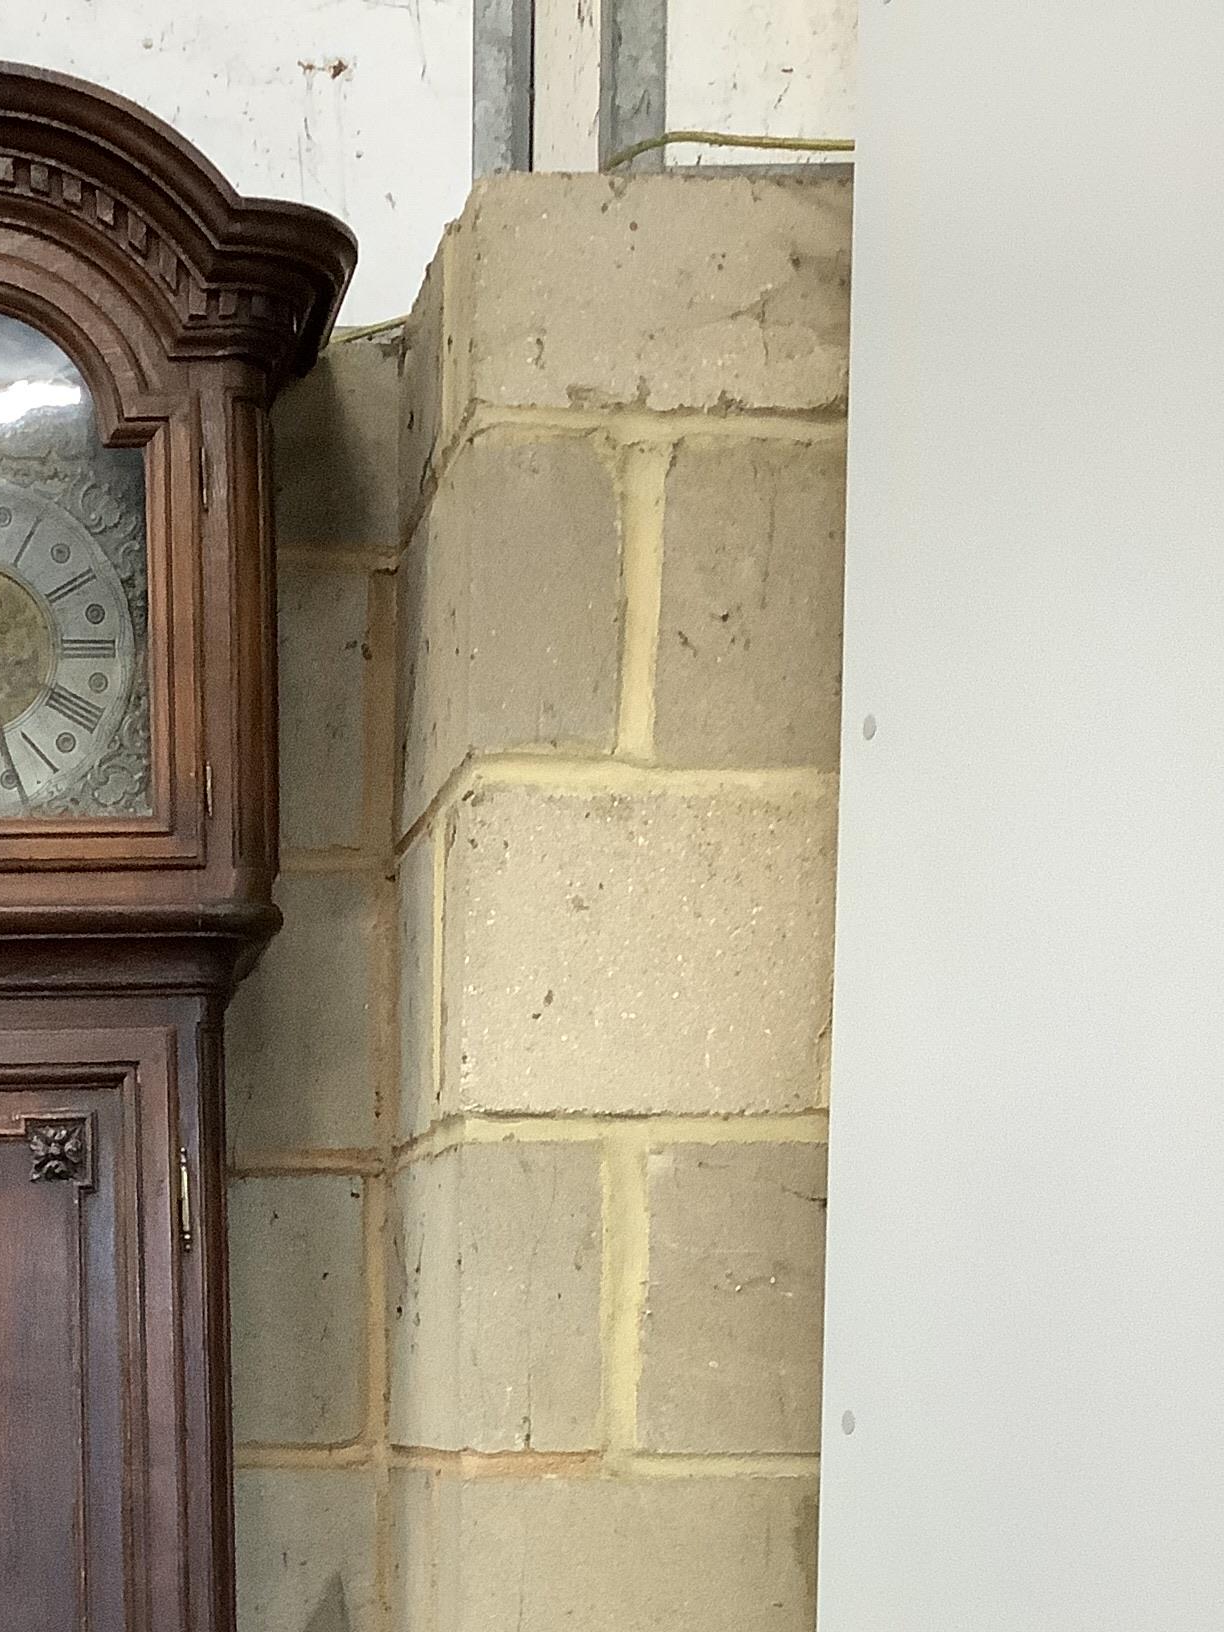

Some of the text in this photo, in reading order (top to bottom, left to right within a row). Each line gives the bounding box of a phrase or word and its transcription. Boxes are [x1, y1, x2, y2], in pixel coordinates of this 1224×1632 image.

[43, 565, 98, 606] II
[60, 638, 117, 660] III
[44, 683, 107, 735] IIII
